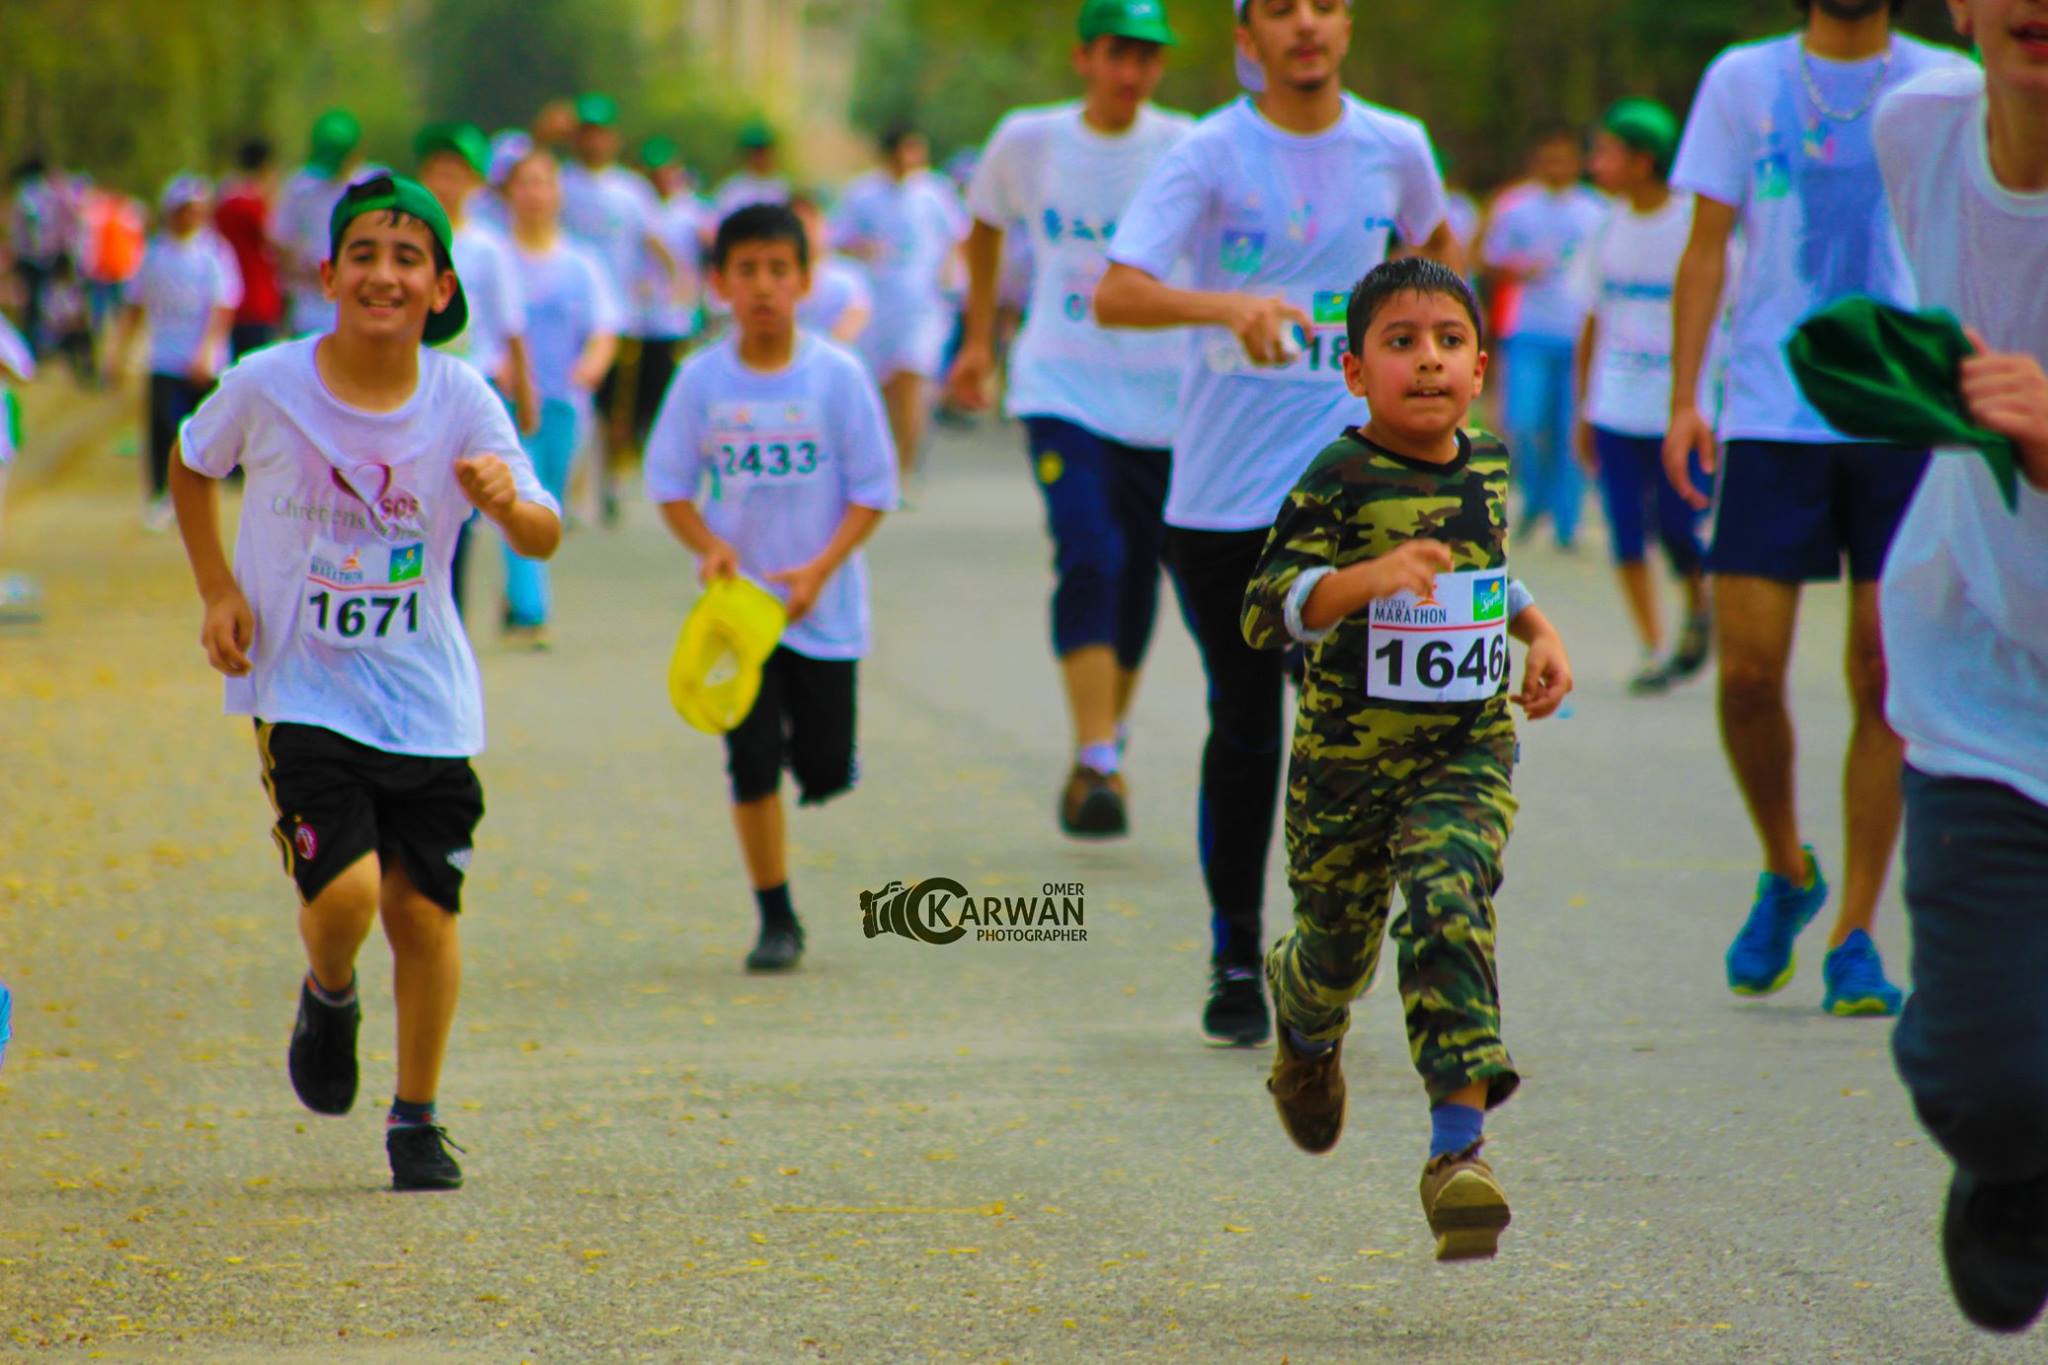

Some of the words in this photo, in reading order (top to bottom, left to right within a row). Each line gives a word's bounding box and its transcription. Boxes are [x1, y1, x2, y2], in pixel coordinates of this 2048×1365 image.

[1303, 333, 1348, 371] 18
[720, 441, 819, 477] 2433
[308, 591, 418, 638] 1671
[1374, 607, 1447, 625] MARATHON
[1375, 633, 1504, 689] 1646
